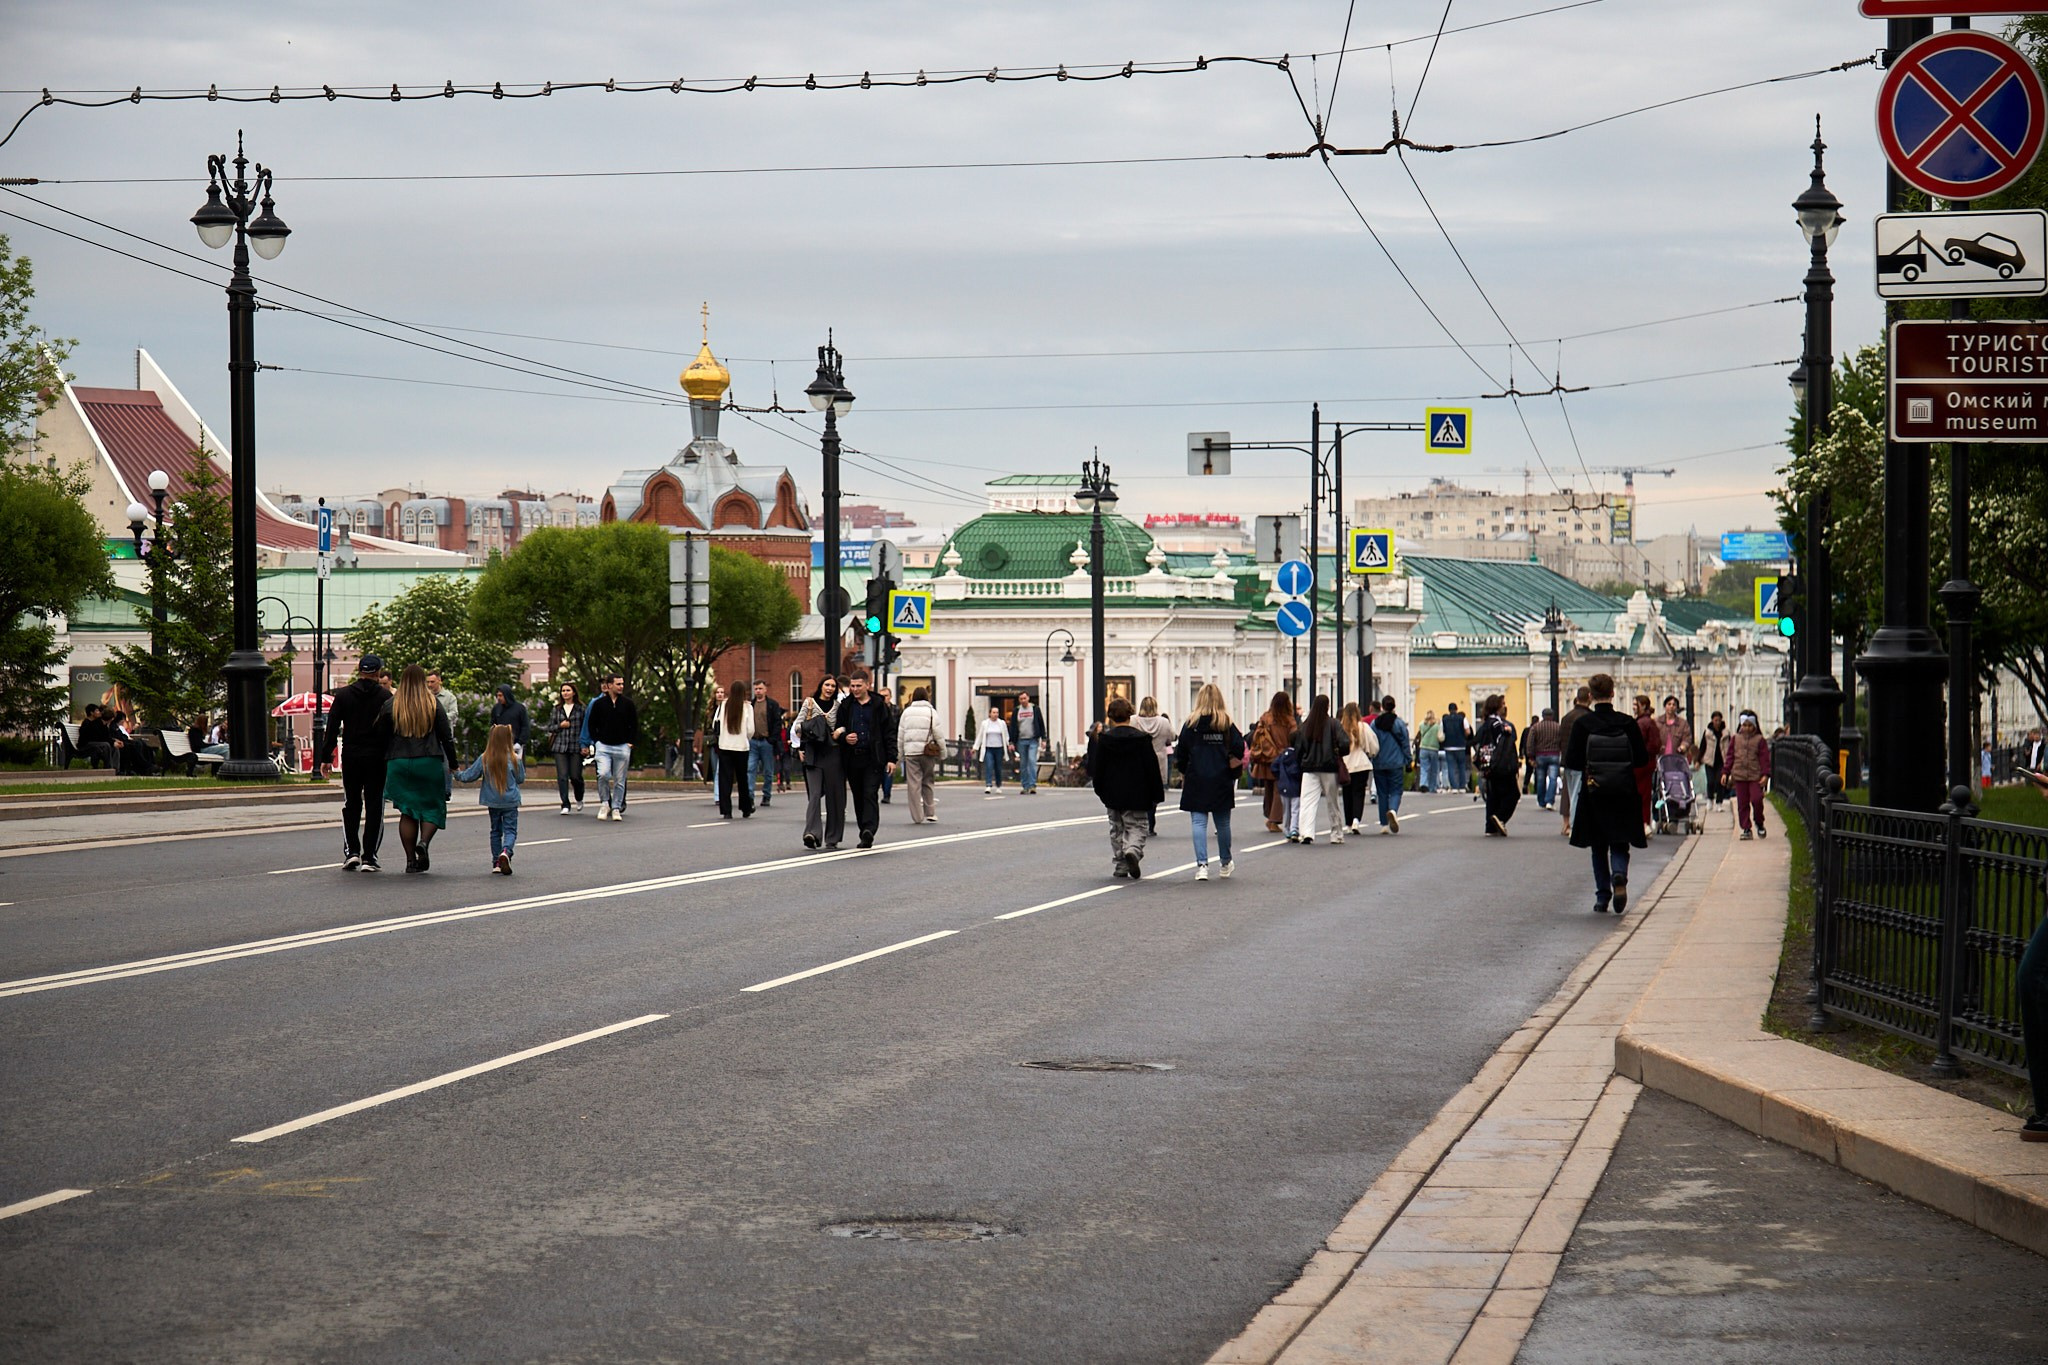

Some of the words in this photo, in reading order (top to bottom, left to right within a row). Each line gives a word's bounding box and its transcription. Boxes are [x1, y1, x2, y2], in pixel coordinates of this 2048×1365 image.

[1947, 356, 2048, 373] TOURIST
[1947, 391, 2033, 409] Омский
[1946, 416, 2037, 430] museum
[320, 511, 329, 547] P
